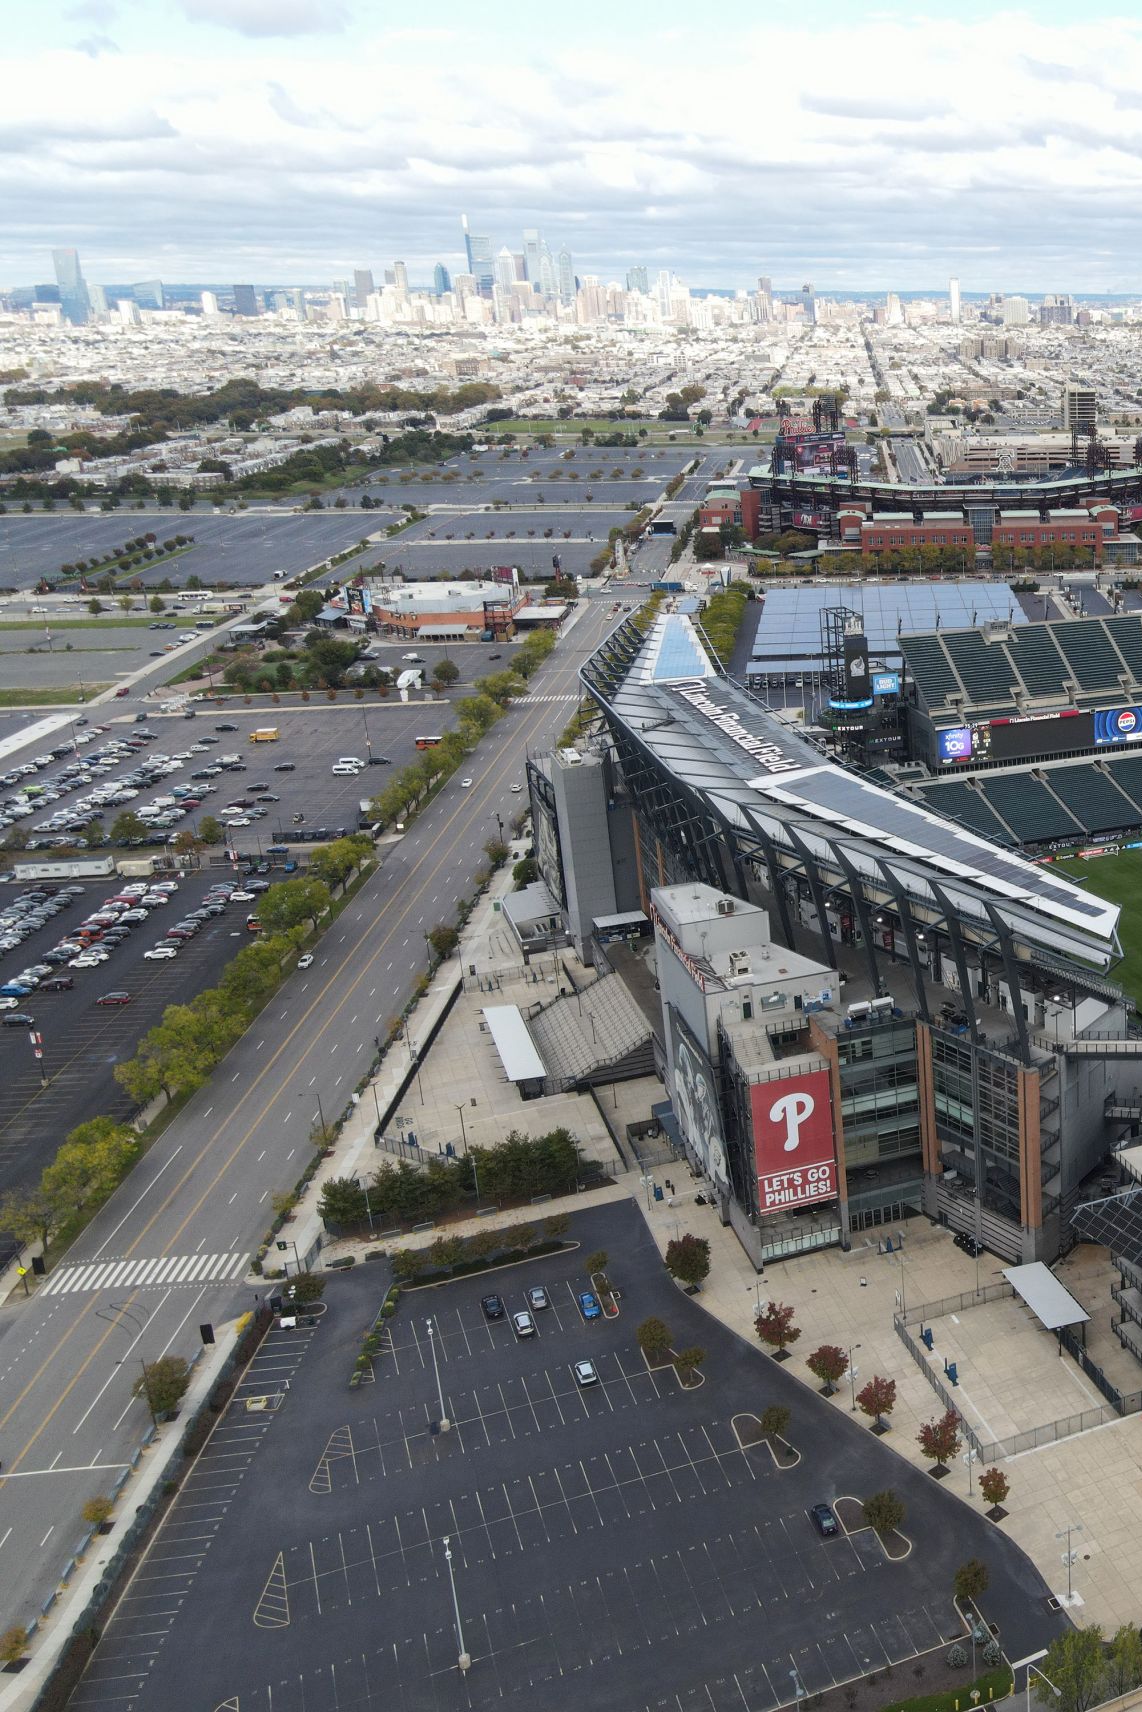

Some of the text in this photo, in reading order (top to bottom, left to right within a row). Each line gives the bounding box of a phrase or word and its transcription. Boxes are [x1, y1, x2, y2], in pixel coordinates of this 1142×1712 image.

[781, 418, 816, 436] Phillies
[680, 688, 802, 774] Lincoln Financial Field
[944, 732, 964, 740] xfinity
[769, 1092, 815, 1152] P
[764, 1166, 830, 1192] LET'S GO
[765, 1180, 831, 1207] PHILLIES!
